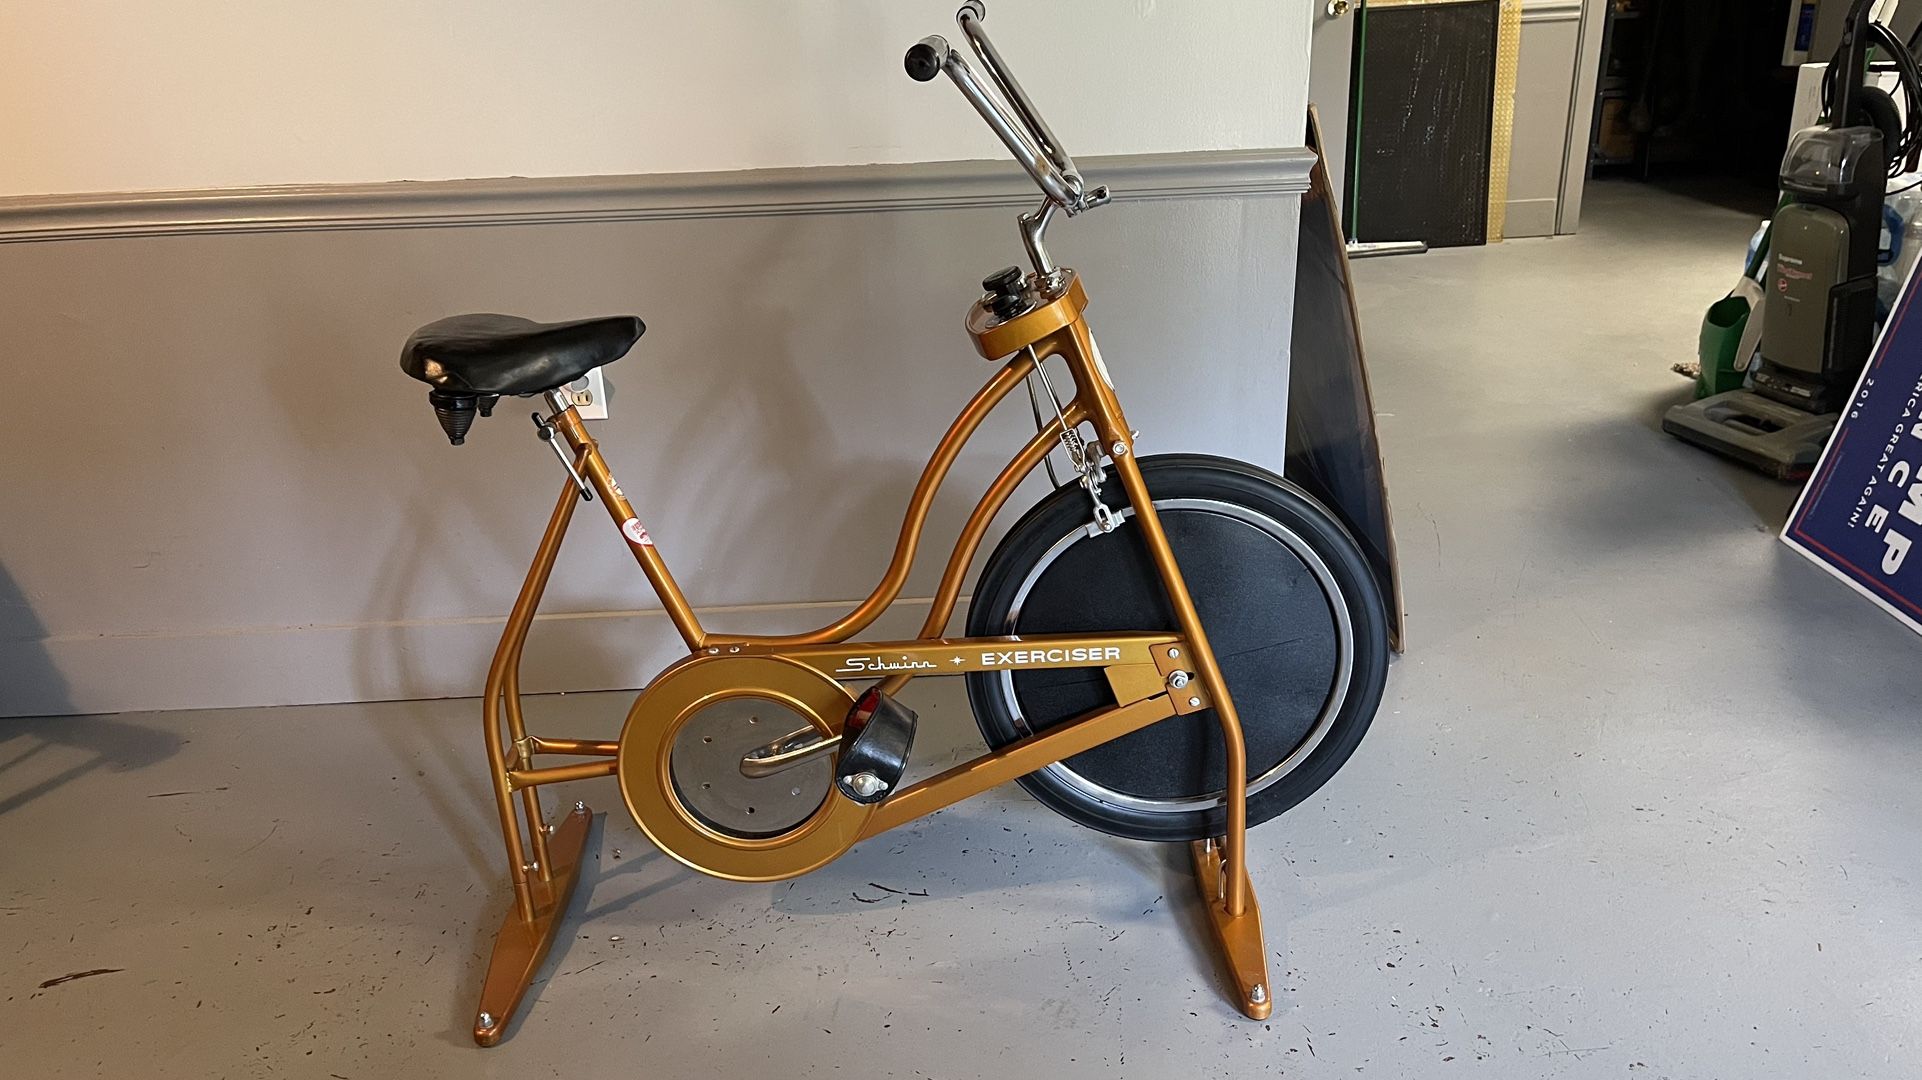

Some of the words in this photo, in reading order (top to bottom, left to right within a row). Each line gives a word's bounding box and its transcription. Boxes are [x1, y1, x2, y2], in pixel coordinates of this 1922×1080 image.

[1851, 378, 1874, 419] 2016
[1902, 374, 1922, 417] RICA
[1877, 423, 1904, 472] GREAT
[1848, 475, 1877, 528] AGAIN!
[836, 655, 937, 672] Schwinn
[981, 647, 1120, 665] EXERCISER
